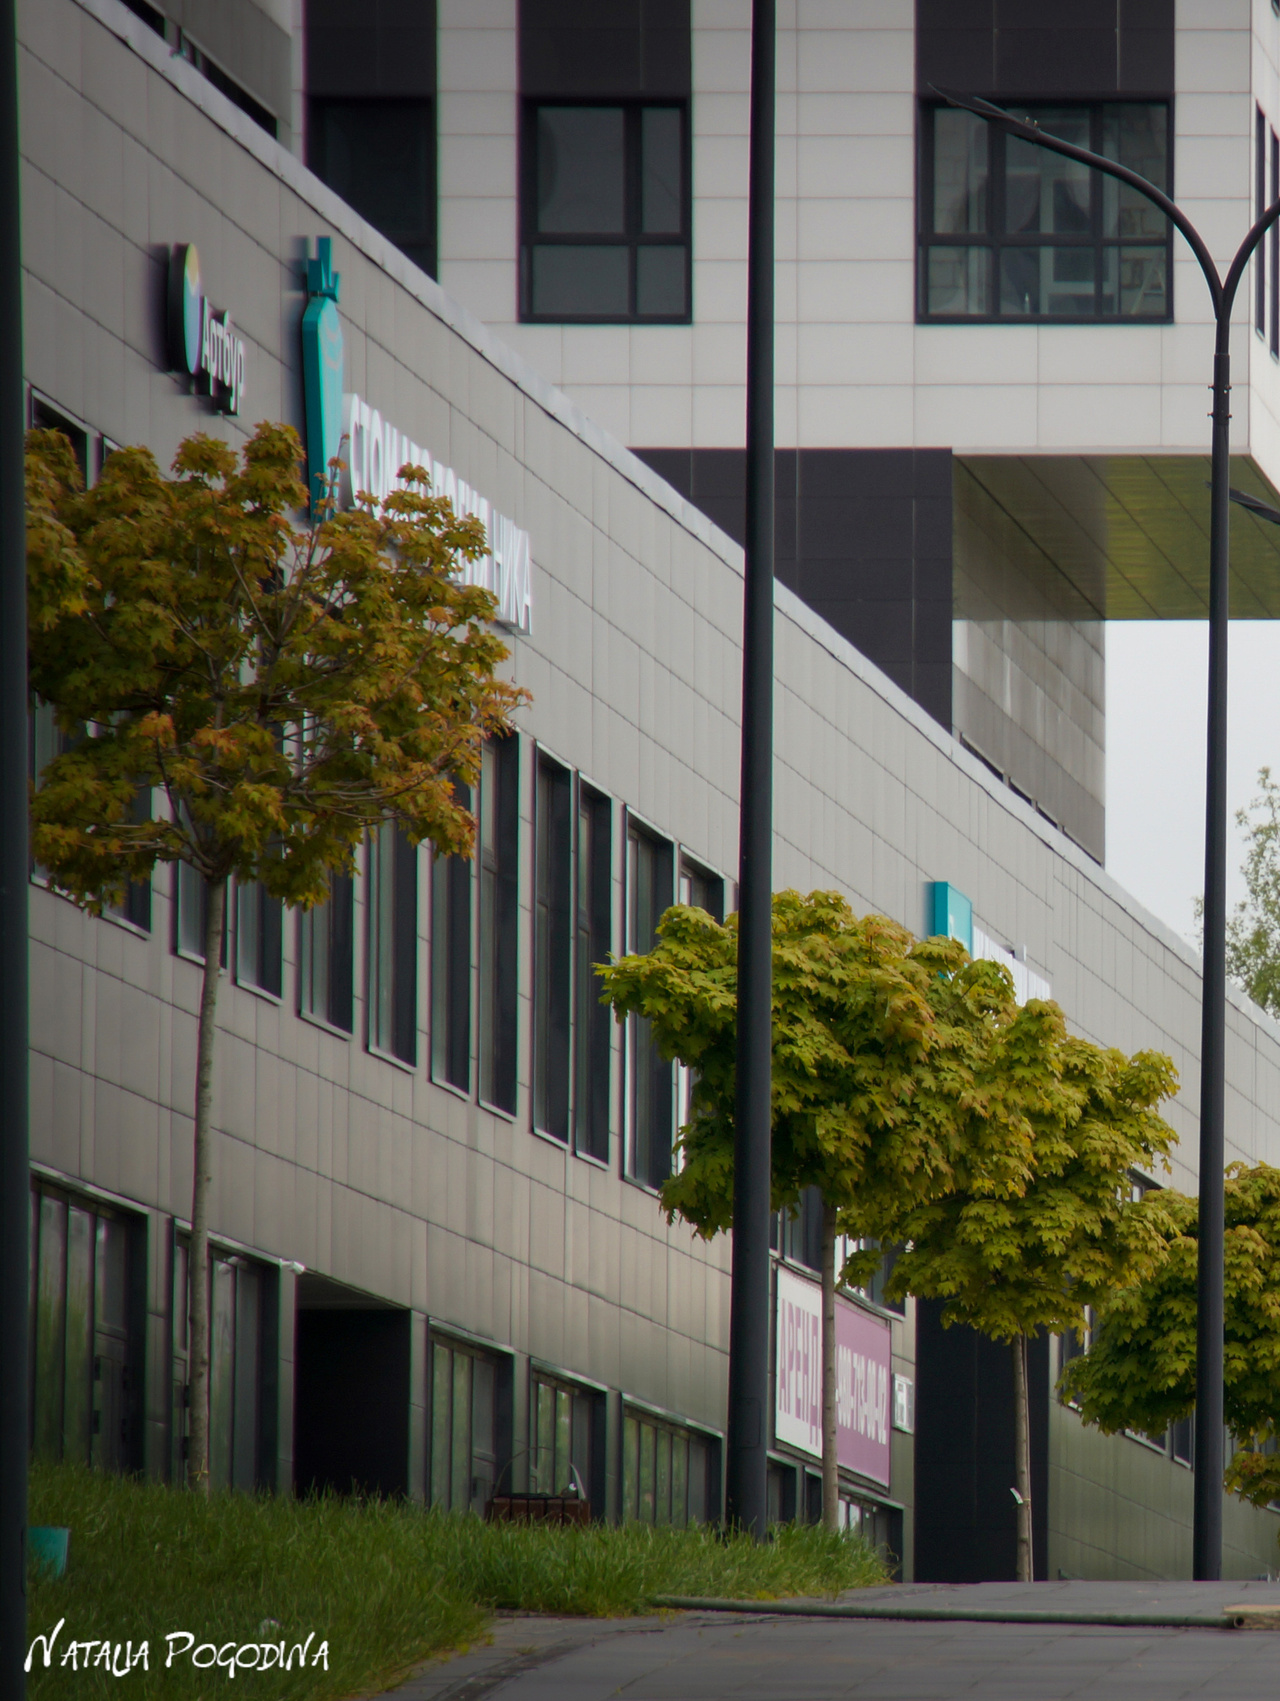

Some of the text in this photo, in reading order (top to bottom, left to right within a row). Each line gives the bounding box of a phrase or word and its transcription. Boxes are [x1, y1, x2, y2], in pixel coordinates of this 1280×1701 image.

[201, 296, 244, 412] Артбур
[492, 506, 532, 635] НИКА
[778, 1298, 822, 1448] АРЕНД
